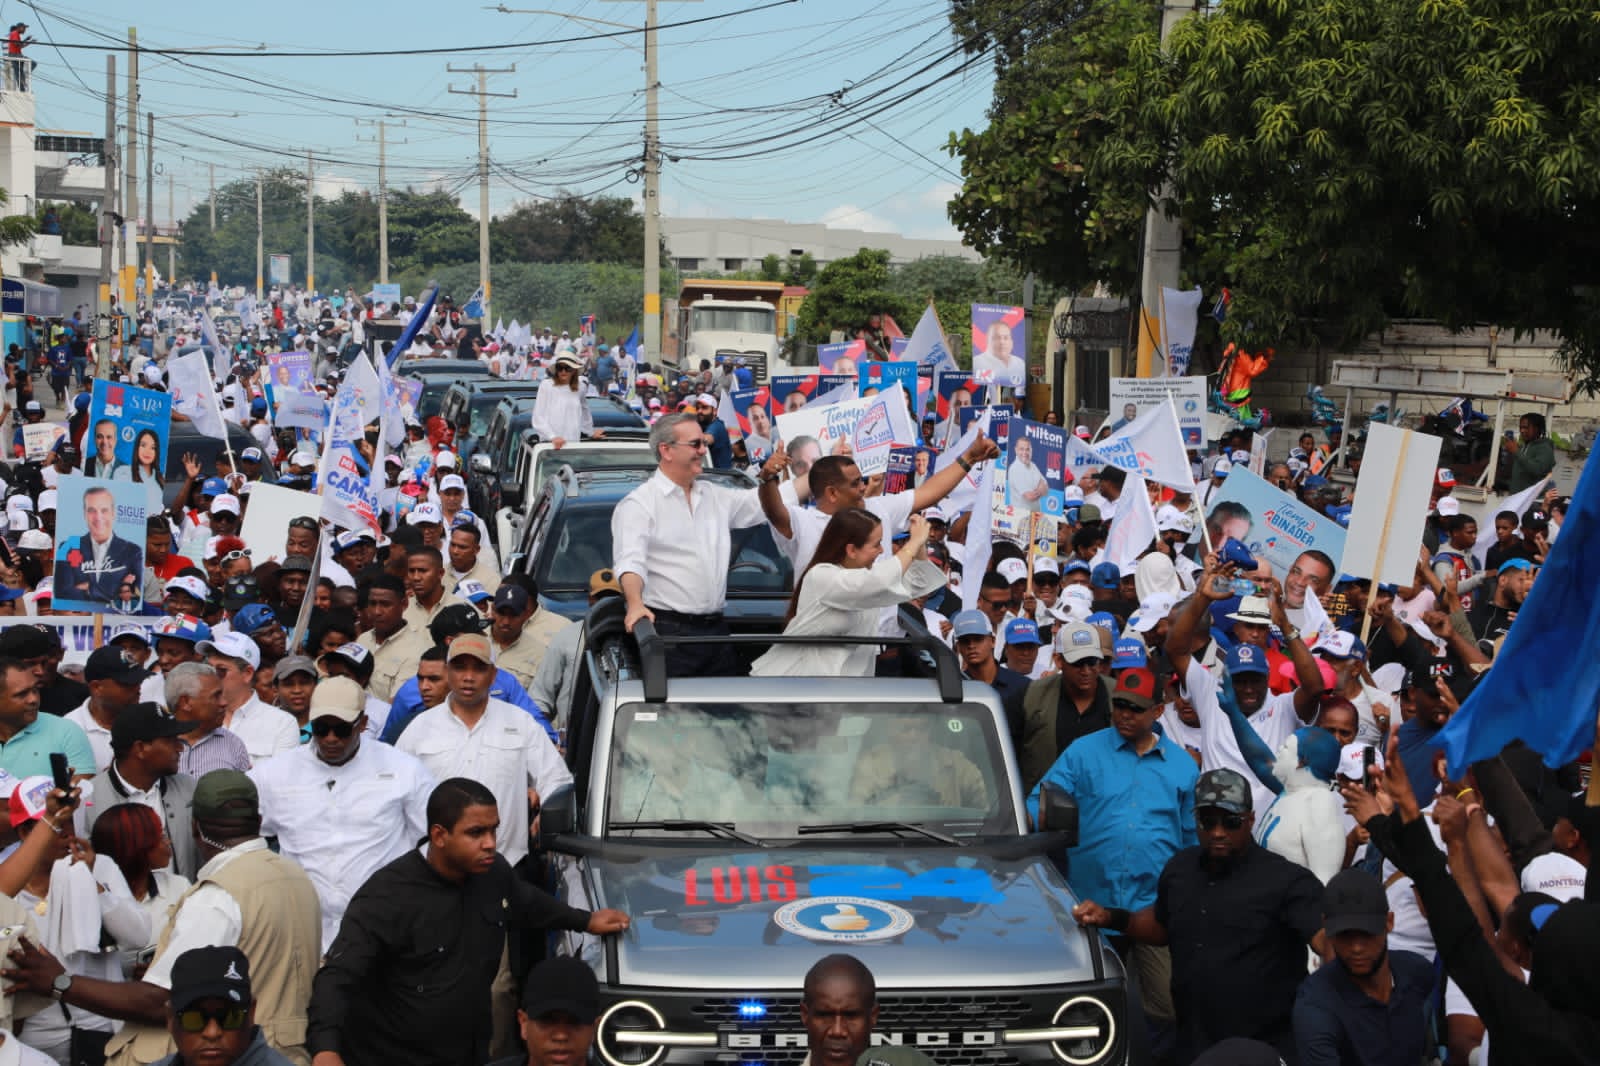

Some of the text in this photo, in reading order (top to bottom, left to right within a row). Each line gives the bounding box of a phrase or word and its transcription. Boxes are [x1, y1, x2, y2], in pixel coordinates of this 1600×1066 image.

[117, 505, 145, 519] SIGUE
[685, 865, 1007, 906] LUIS 24
[1539, 879, 1585, 889] MONTERO
[728, 1031, 996, 1048] BRNCO
